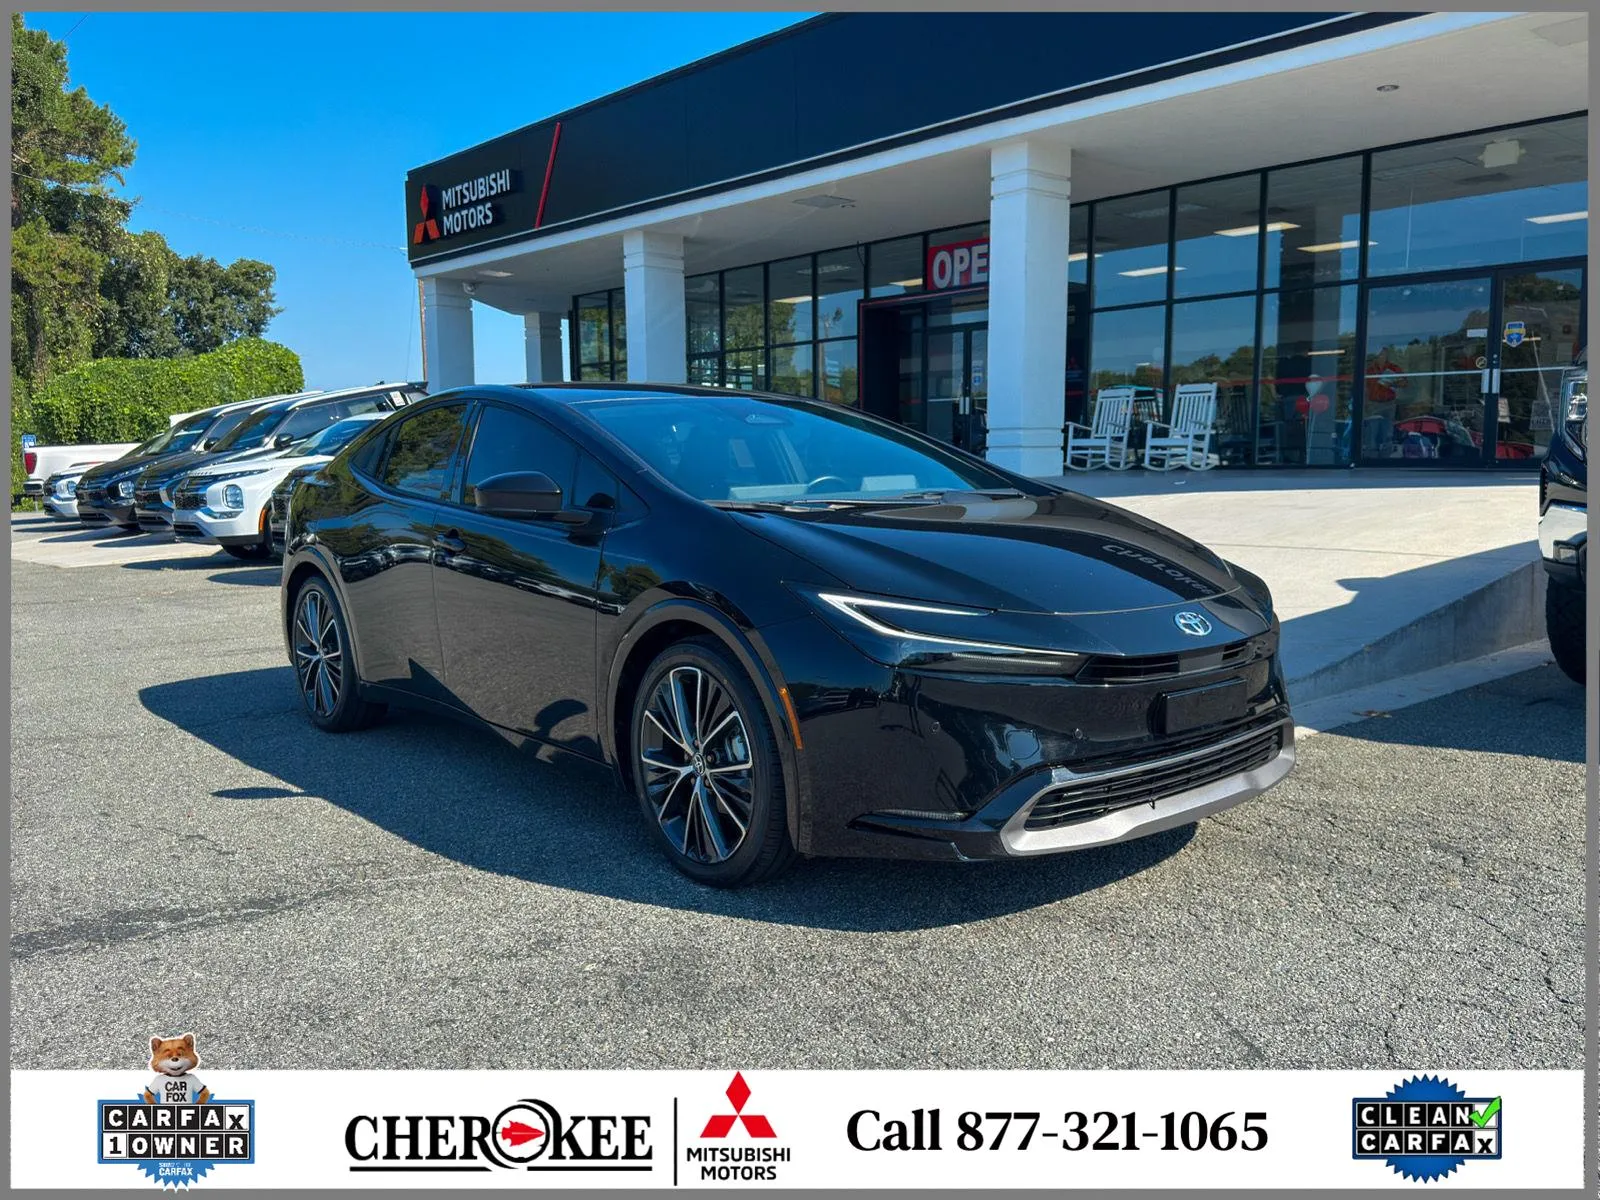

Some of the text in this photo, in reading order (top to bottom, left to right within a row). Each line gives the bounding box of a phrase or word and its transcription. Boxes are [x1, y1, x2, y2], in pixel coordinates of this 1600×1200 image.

[442, 169, 510, 210] MITSUBISHI
[442, 202, 494, 236] MOTORS
[932, 244, 988, 289] OPE
